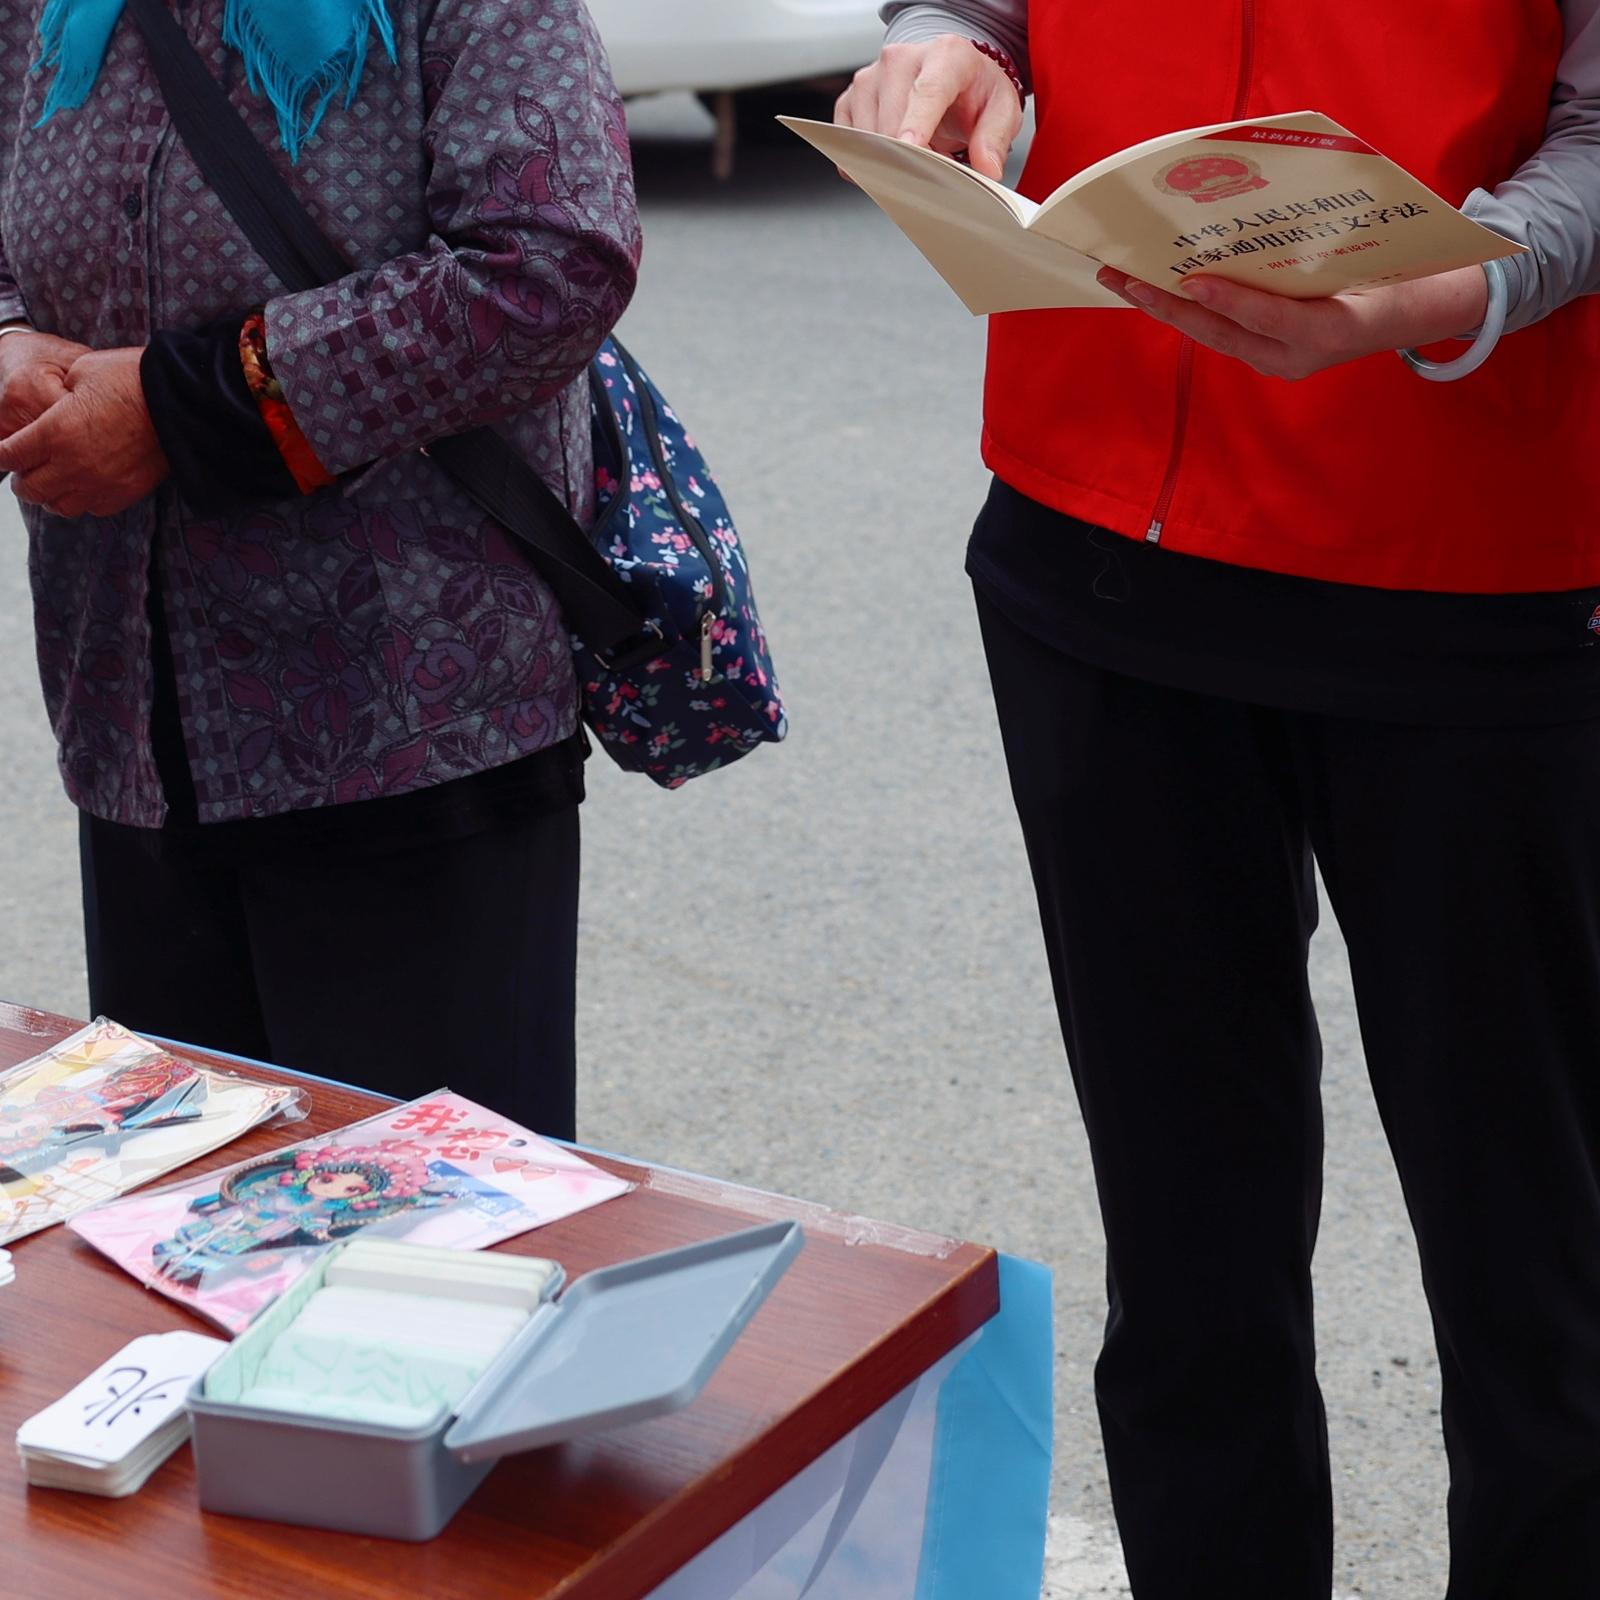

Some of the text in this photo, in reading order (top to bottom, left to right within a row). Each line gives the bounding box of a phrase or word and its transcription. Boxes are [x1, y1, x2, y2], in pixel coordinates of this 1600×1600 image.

[1169, 202, 1429, 276] 国家通用语言文字法
[1173, 188, 1376, 249] 中华人民共和国
[82, 1364, 191, 1428] 兆
